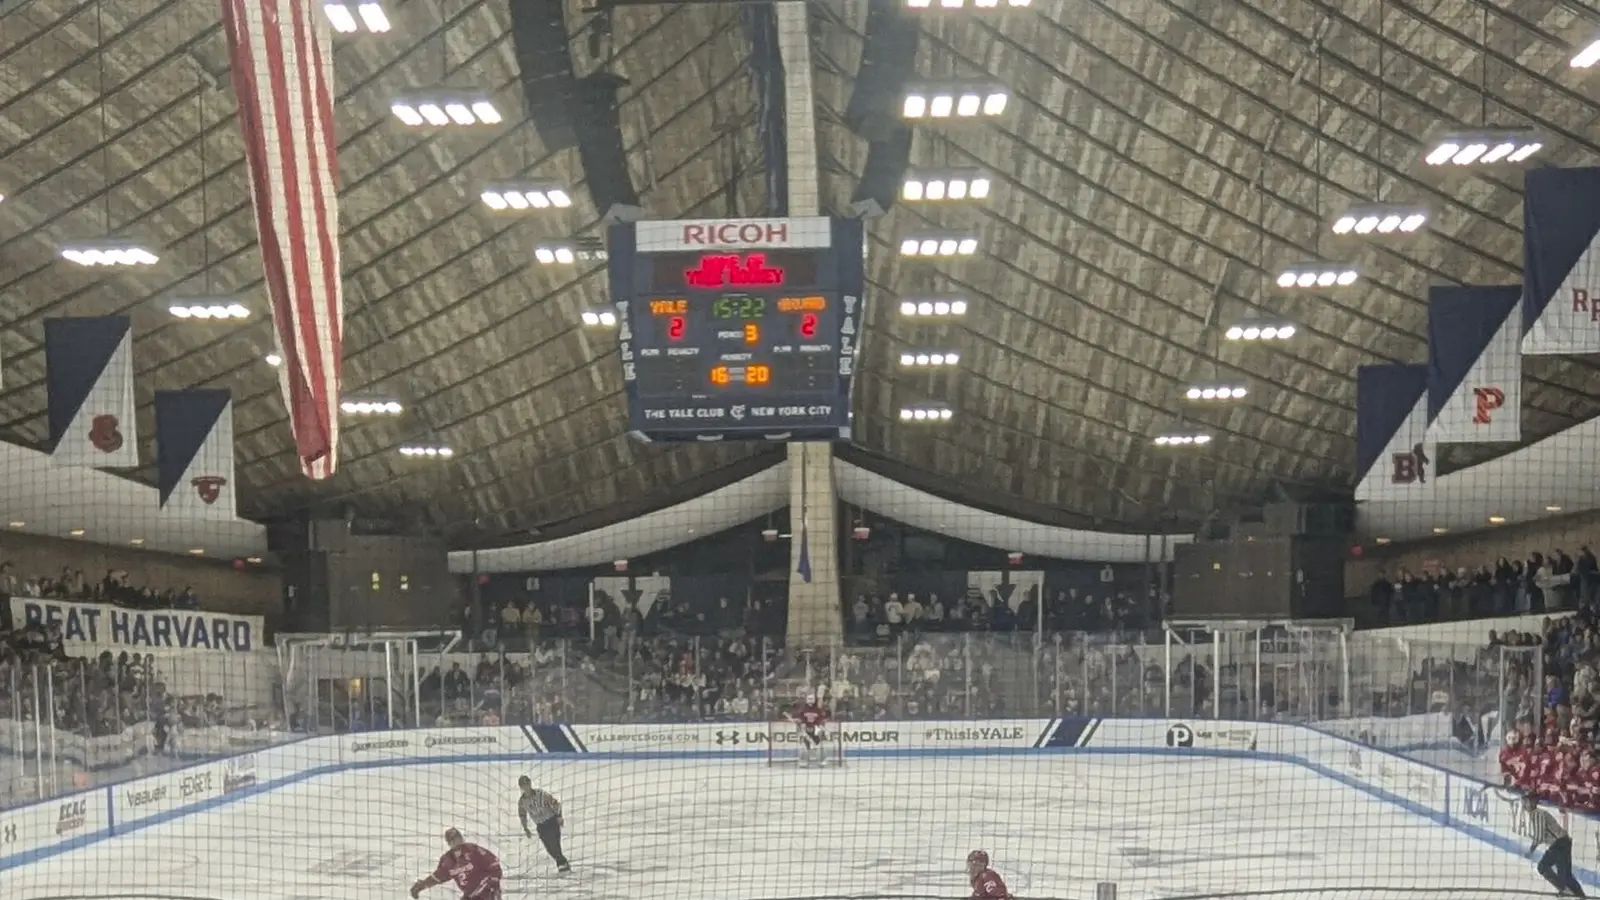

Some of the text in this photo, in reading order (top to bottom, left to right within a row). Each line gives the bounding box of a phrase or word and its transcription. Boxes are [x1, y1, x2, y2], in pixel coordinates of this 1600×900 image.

[684, 223, 788, 244] RICOH
[650, 300, 688, 315] YALE
[714, 299, 764, 318] 15:22
[670, 318, 683, 337] 2
[745, 324, 757, 342] 3
[801, 315, 816, 336] 2
[711, 367, 728, 384] 16
[746, 366, 769, 383] 20
[644, 407, 725, 419] THE YALE CLUB
[751, 405, 832, 417] NEW YORK CITY
[1472, 387, 1505, 425] P
[25, 603, 250, 652] BEAT HARVARD
[745, 732, 810, 743] UNDE
[926, 727, 1024, 741] #ThisIsYALE
